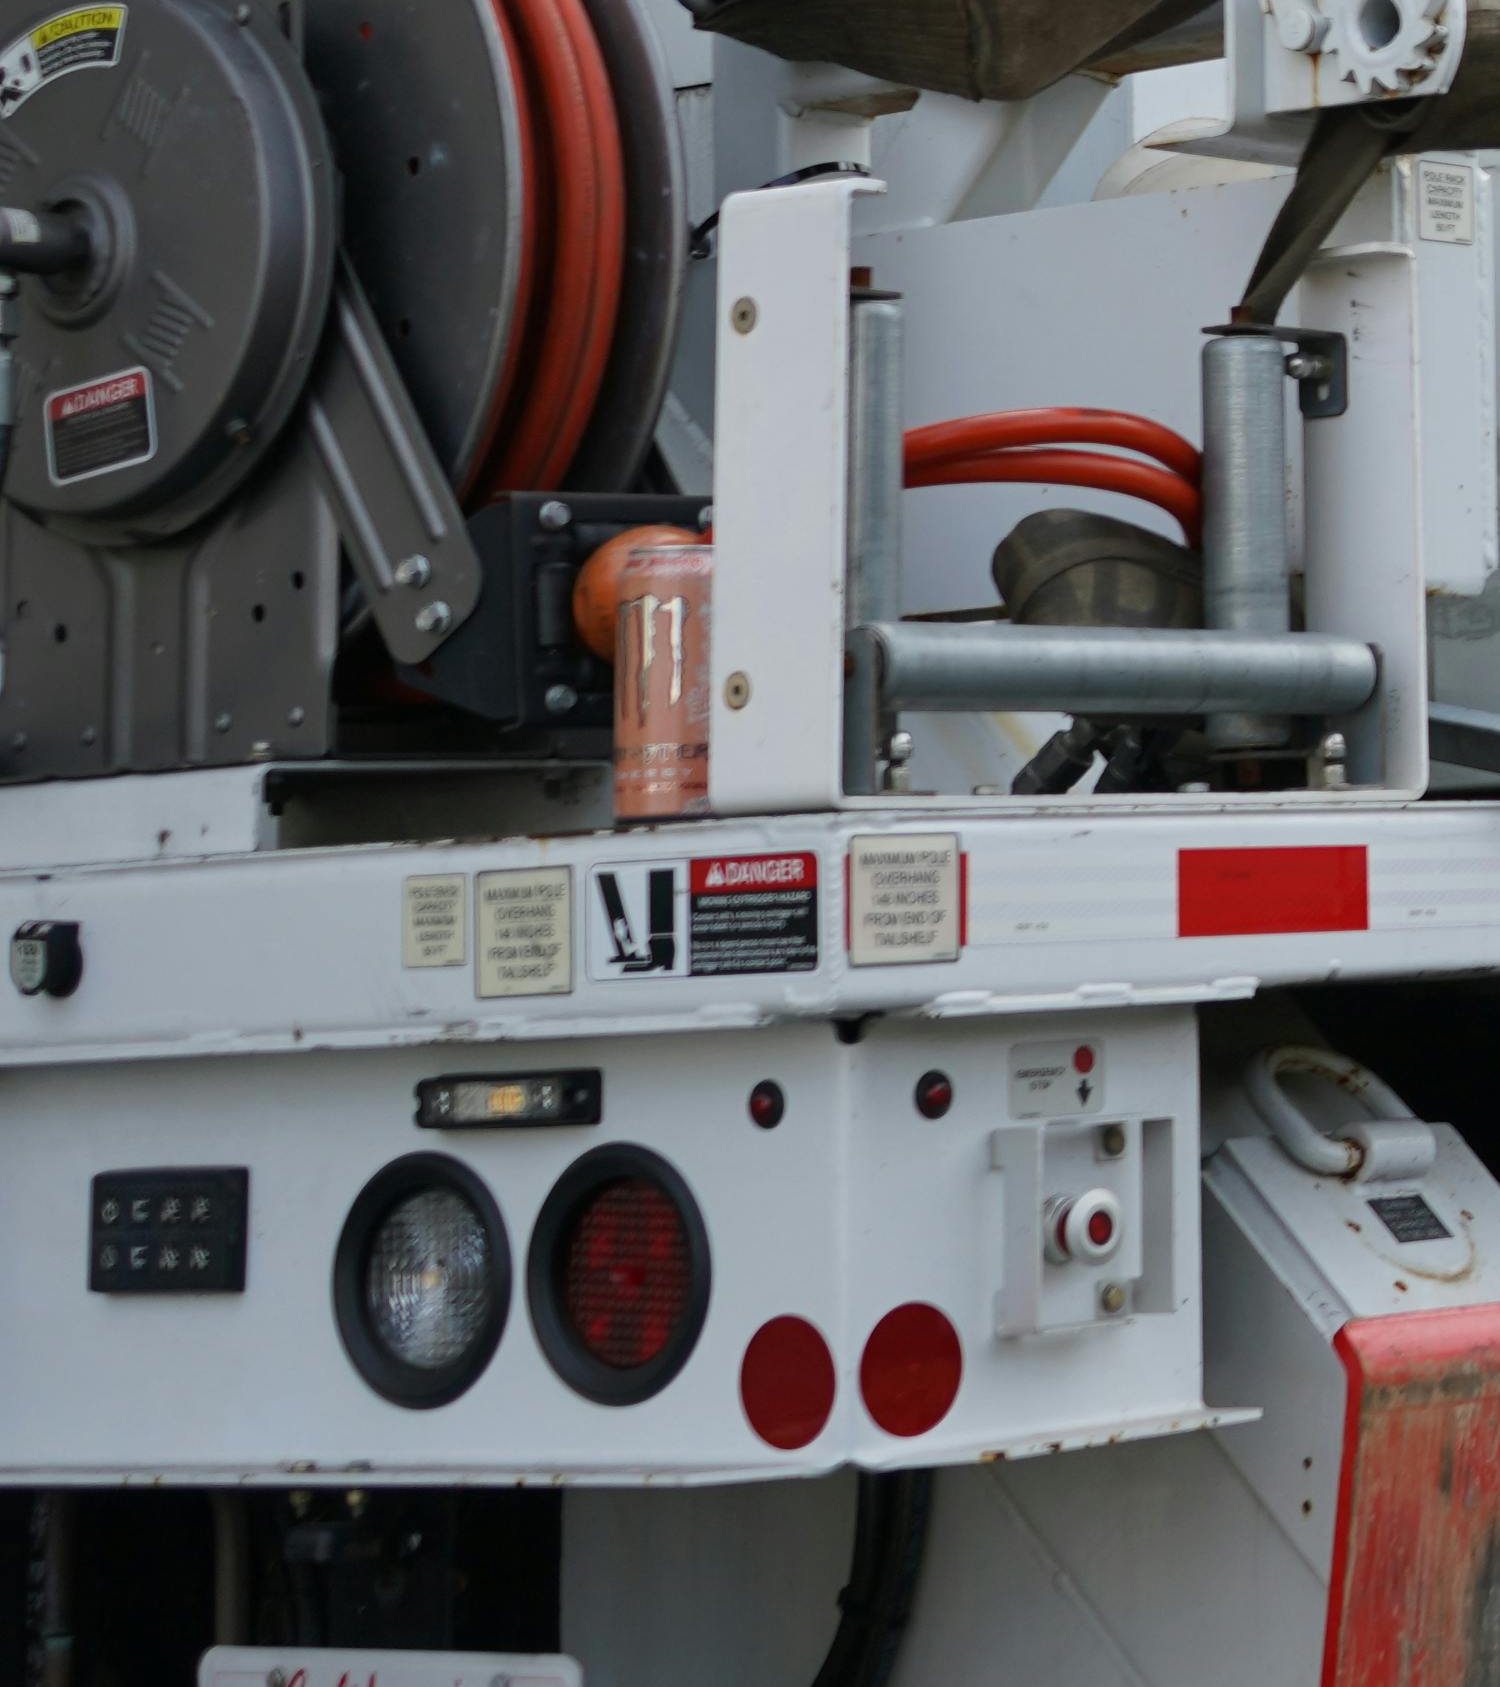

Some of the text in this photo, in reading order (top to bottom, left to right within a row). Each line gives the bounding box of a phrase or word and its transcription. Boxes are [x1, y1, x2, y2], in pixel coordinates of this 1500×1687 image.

[49, 12, 113, 36] CAUTION
[74, 378, 137, 408] DANGER
[860, 850, 951, 866] MAXIMUM POLE
[725, 859, 804, 884] DANGER
[872, 870, 940, 886] OVERHANG
[896, 890, 939, 905] INCHES
[496, 904, 556, 921] OVERHANG
[864, 909, 947, 927] FROM END OF
[875, 930, 939, 946] TAILSHELF
[1015, 1066, 1066, 1079] EMERGENCY
